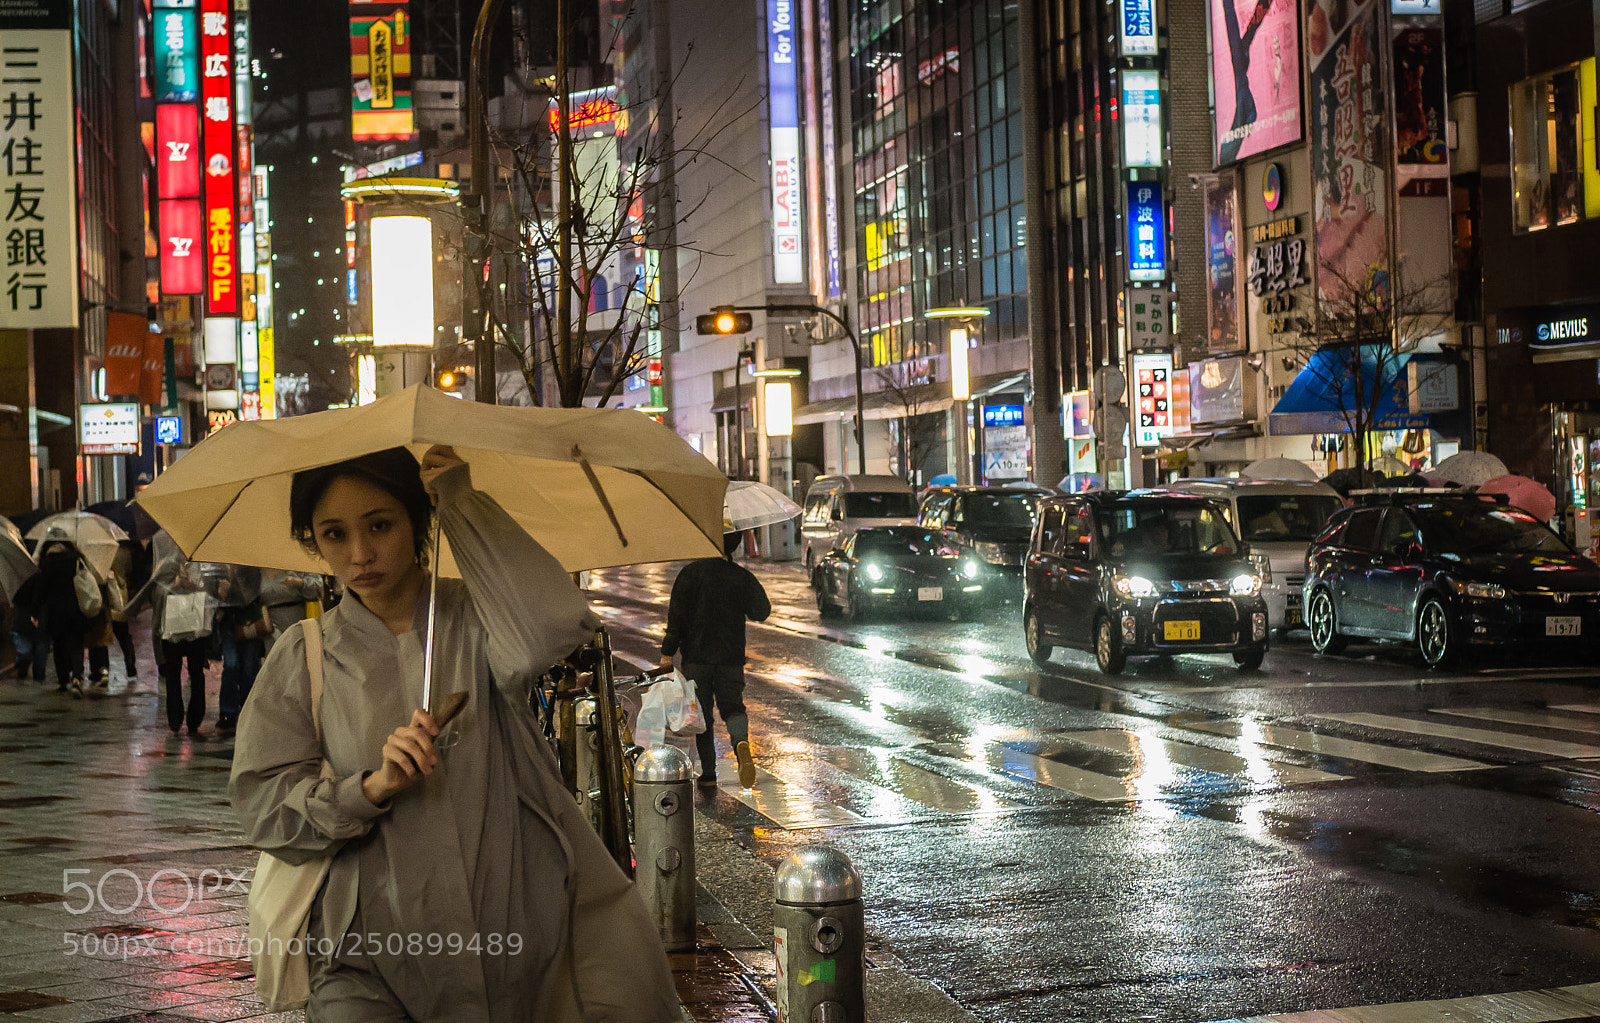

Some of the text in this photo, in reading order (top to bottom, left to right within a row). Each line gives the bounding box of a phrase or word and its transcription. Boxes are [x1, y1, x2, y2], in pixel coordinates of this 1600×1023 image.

[772, 0, 791, 64] For You
[202, 11, 229, 122] 歌広場
[2, 47, 48, 311] 三井住友銀行
[166, 141, 190, 162] Y!
[775, 160, 789, 227] LABI
[790, 156, 798, 227] SHIBUYA
[169, 236, 193, 257] Y!
[210, 207, 233, 301] 受付5F
[1137, 188, 1156, 260] 伊波歯科
[1141, 338, 1157, 347] 7F
[1150, 293, 1163, 334] なかの
[1549, 318, 1588, 340] MEVIUS
[108, 344, 142, 358] au
